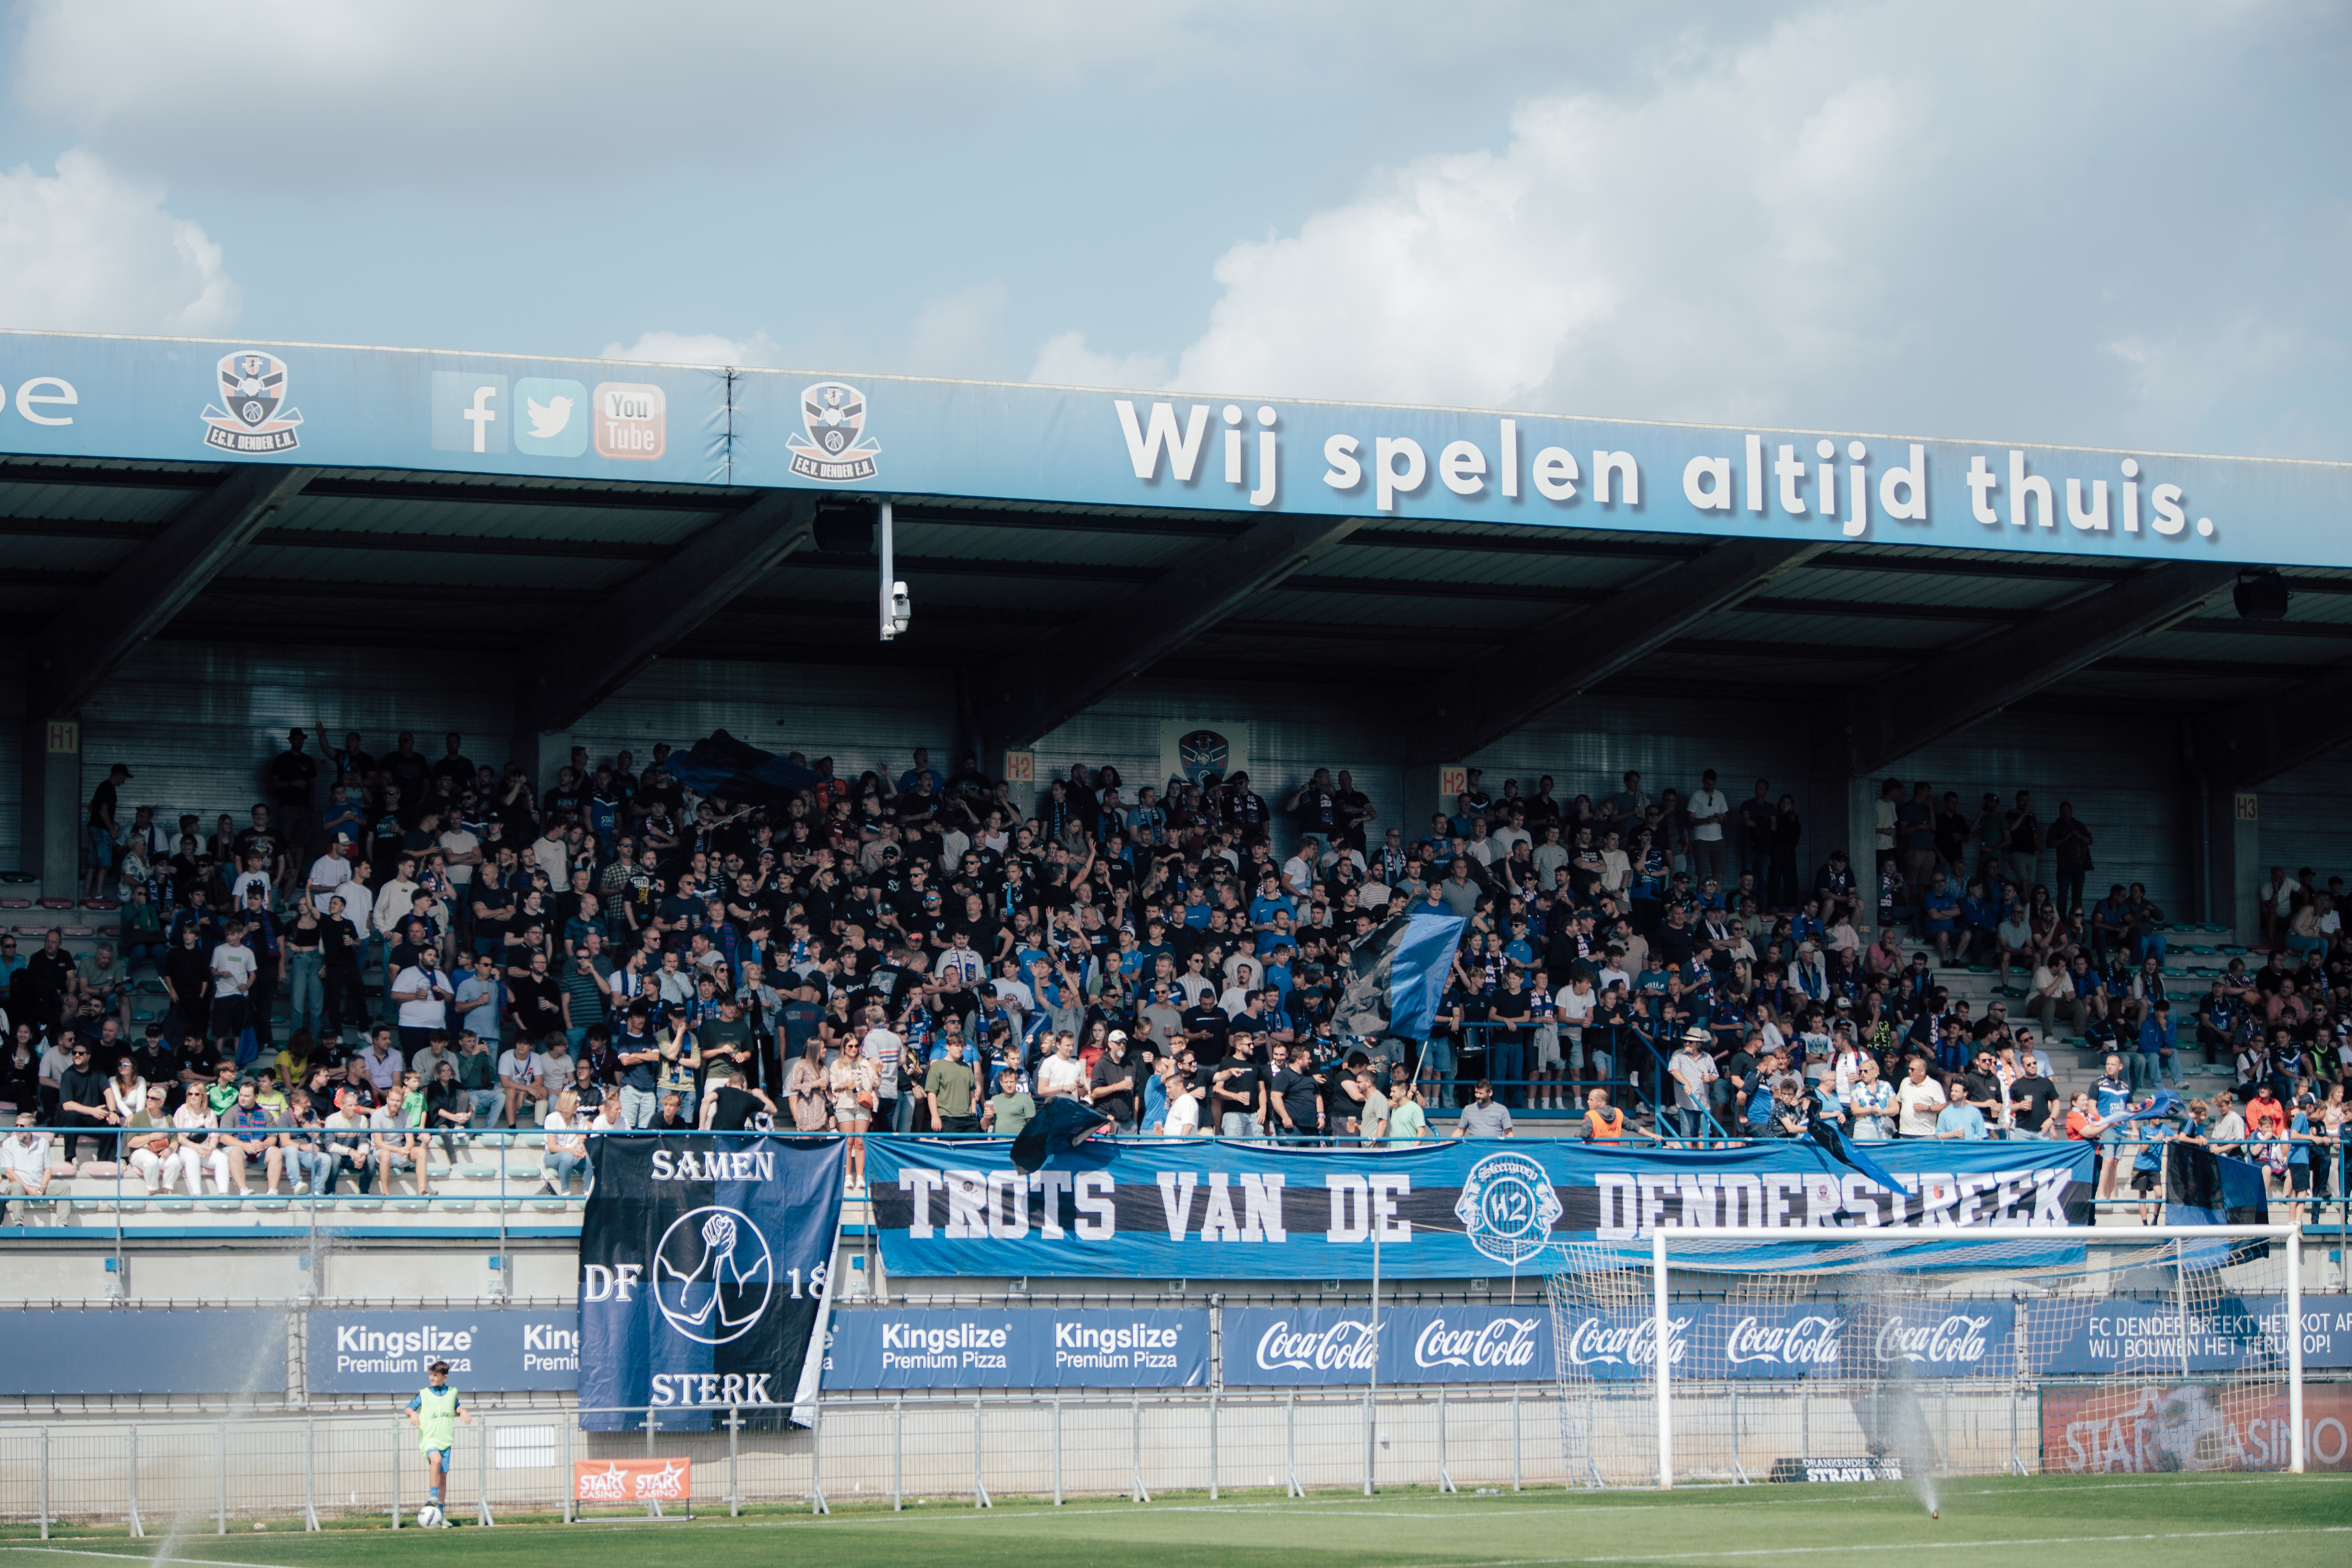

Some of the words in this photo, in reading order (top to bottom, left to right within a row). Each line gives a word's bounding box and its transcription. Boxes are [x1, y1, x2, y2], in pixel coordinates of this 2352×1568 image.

[0, 377, 78, 425] e
[611, 395, 647, 419] You
[237, 436, 275, 450] DENDER
[275, 432, 295, 447] E.H.
[606, 421, 654, 451] Tube
[820, 463, 854, 478] DENDER
[854, 460, 873, 476] E.H.
[1113, 400, 1277, 506] Wij
[1323, 419, 1638, 510] spelen
[1683, 434, 1927, 536] altijd
[1967, 450, 2214, 536] thuis.
[50, 725, 74, 749] H1
[1008, 755, 1030, 779] H2
[1443, 771, 1465, 793] H2
[2238, 798, 2257, 819] H3
[651, 1150, 774, 1181] SAMEN
[898, 1168, 1116, 1241] TROTS
[1157, 1172, 1287, 1242] VAN
[1326, 1174, 1412, 1243] DE
[1491, 1192, 1527, 1222] H2
[1595, 1168, 2072, 1240] DENDERSTREEK
[584, 1264, 642, 1302] DF
[787, 1260, 827, 1299] 18
[2089, 1317, 2111, 1336] FC
[2116, 1316, 2181, 1336] DENDER
[2190, 1315, 2253, 1334] BREEKT
[2259, 1314, 2289, 1333] HET
[1256, 1320, 1386, 1370] Coca-Cola
[1415, 1318, 1541, 1368] Coca-Cola
[1727, 1316, 1848, 1364] Coca-Cola
[1876, 1316, 1992, 1363] Coca-Cola
[2089, 1339, 2118, 1358] WIJ
[2124, 1337, 2199, 1358] BOUWEN
[2205, 1337, 2238, 1356] HET
[2243, 1335, 2289, 1354] TERU
[2303, 1334, 2330, 1353] OP!
[338, 1354, 418, 1373] Premium
[883, 1351, 957, 1369] Premium
[963, 1351, 1007, 1368] Pizza
[1056, 1351, 1129, 1368] Premium
[1134, 1351, 1177, 1368] Pizza
[650, 1373, 774, 1405] STERK
[580, 1474, 619, 1491] STAR
[635, 1473, 675, 1490] STAR
[635, 1489, 678, 1498] CASINO
[579, 1490, 623, 1499] CASINO
